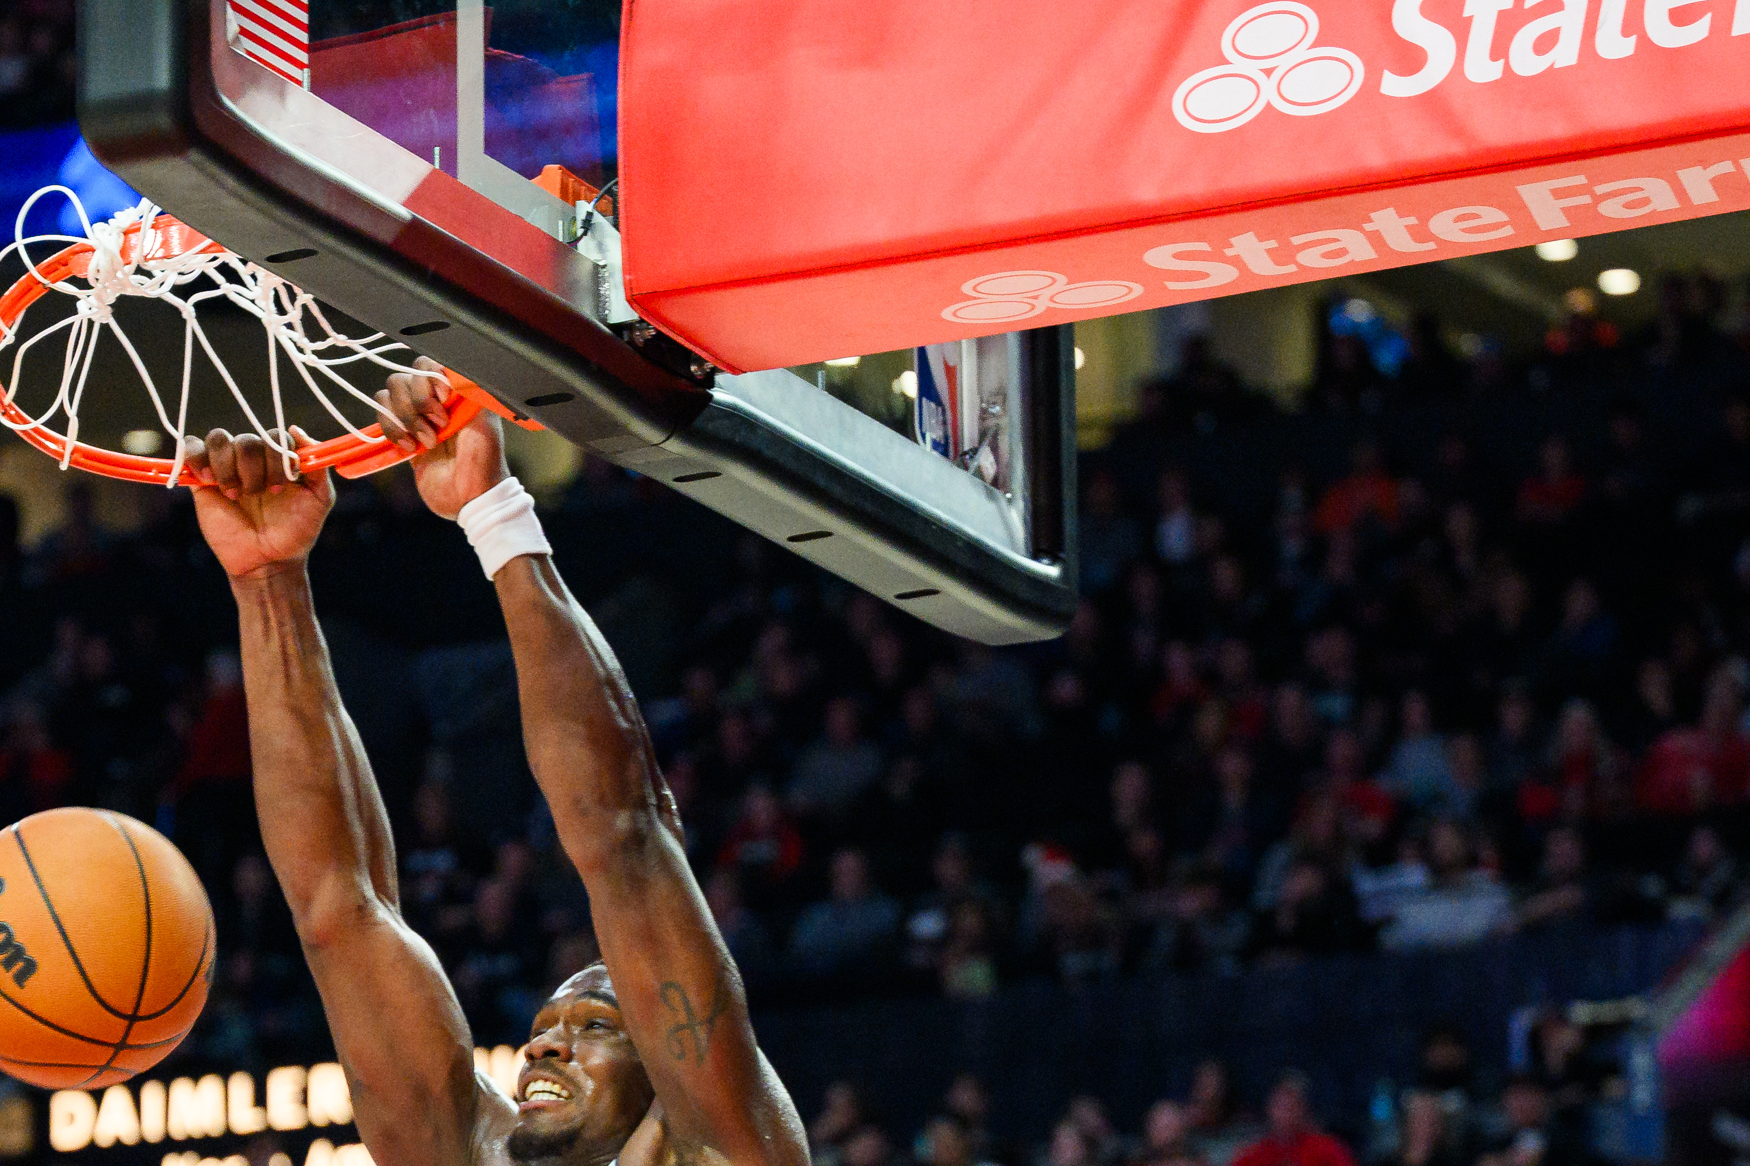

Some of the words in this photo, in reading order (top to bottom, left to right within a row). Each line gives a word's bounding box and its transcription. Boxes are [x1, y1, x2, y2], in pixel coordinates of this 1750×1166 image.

[1379, 0, 1712, 97] State
[1142, 203, 1516, 291] State
[1516, 158, 1750, 231] Far
